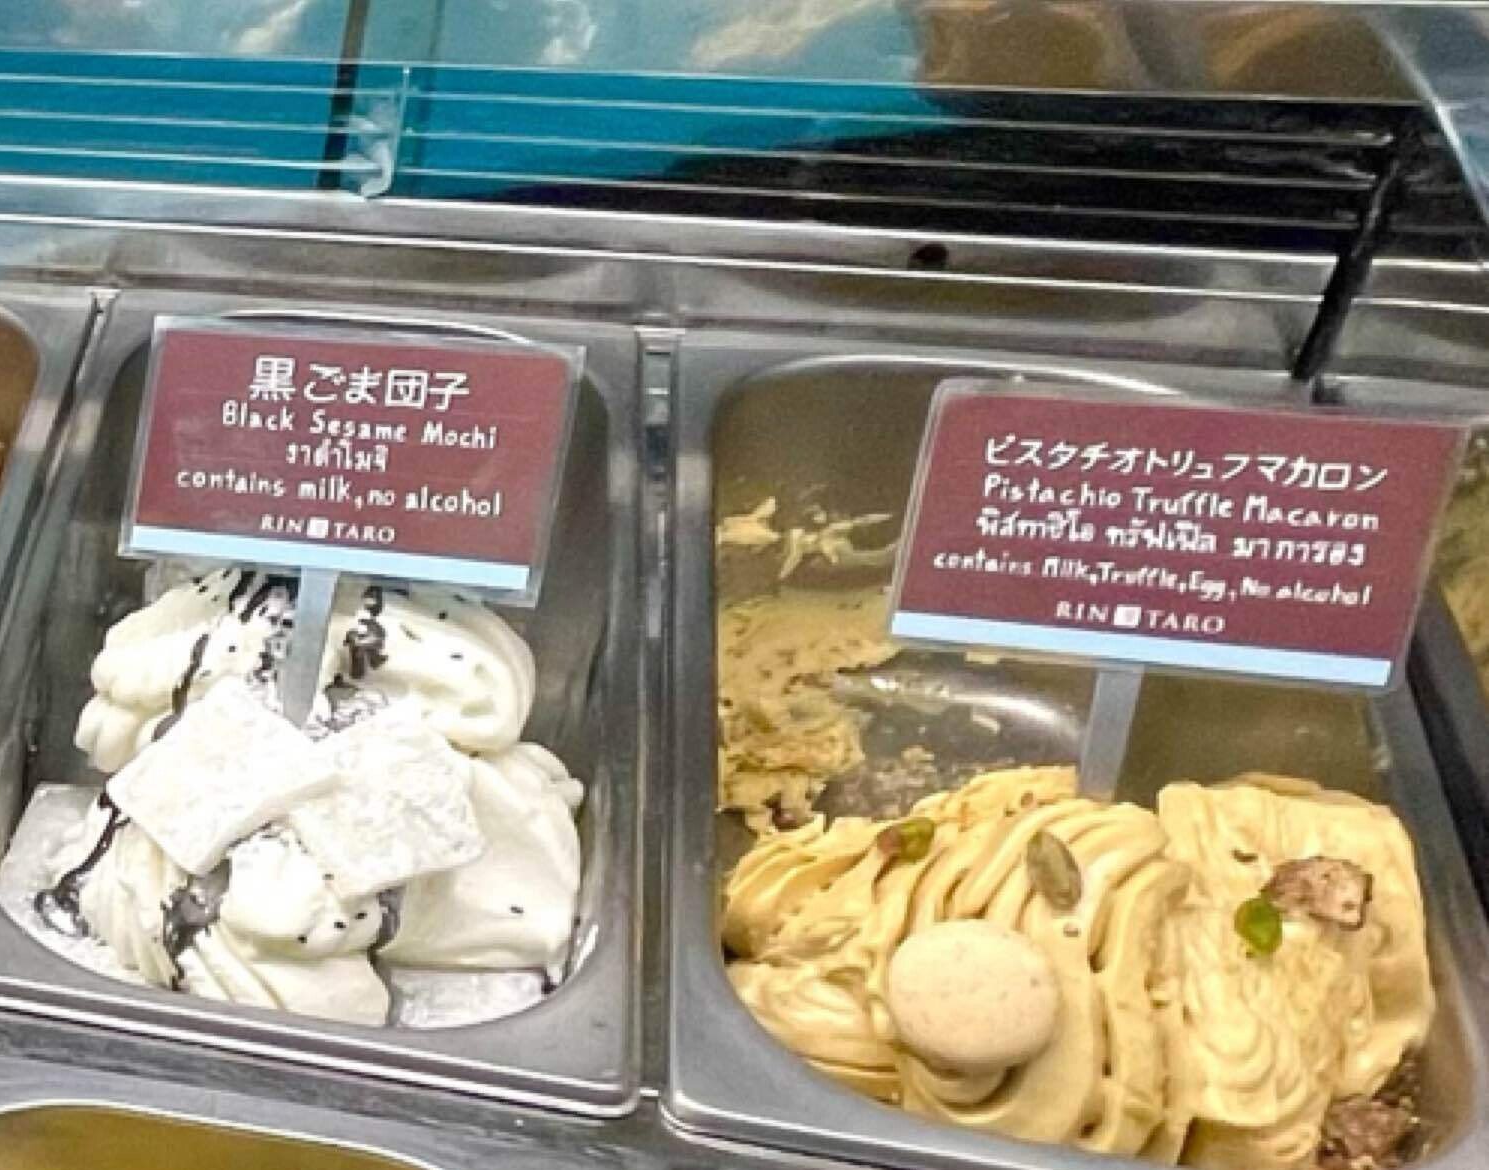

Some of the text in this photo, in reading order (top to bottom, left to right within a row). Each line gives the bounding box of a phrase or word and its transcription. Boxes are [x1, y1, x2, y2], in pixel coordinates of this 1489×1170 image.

[249, 354, 470, 411] 黒ごま団子
[222, 400, 498, 450] Black Sesame Mochi
[984, 435, 1388, 491] ピスタチオトリュフマカロン
[176, 467, 285, 496] contains
[405, 487, 503, 518] alcohol
[983, 473, 1380, 531] Pistachio Truffle Macaron
[261, 514, 395, 544] RIN TARO
[933, 551, 1032, 577] contains
[1276, 577, 1372, 606] alcohol
[1056, 600, 1226, 634] RIN TARO
